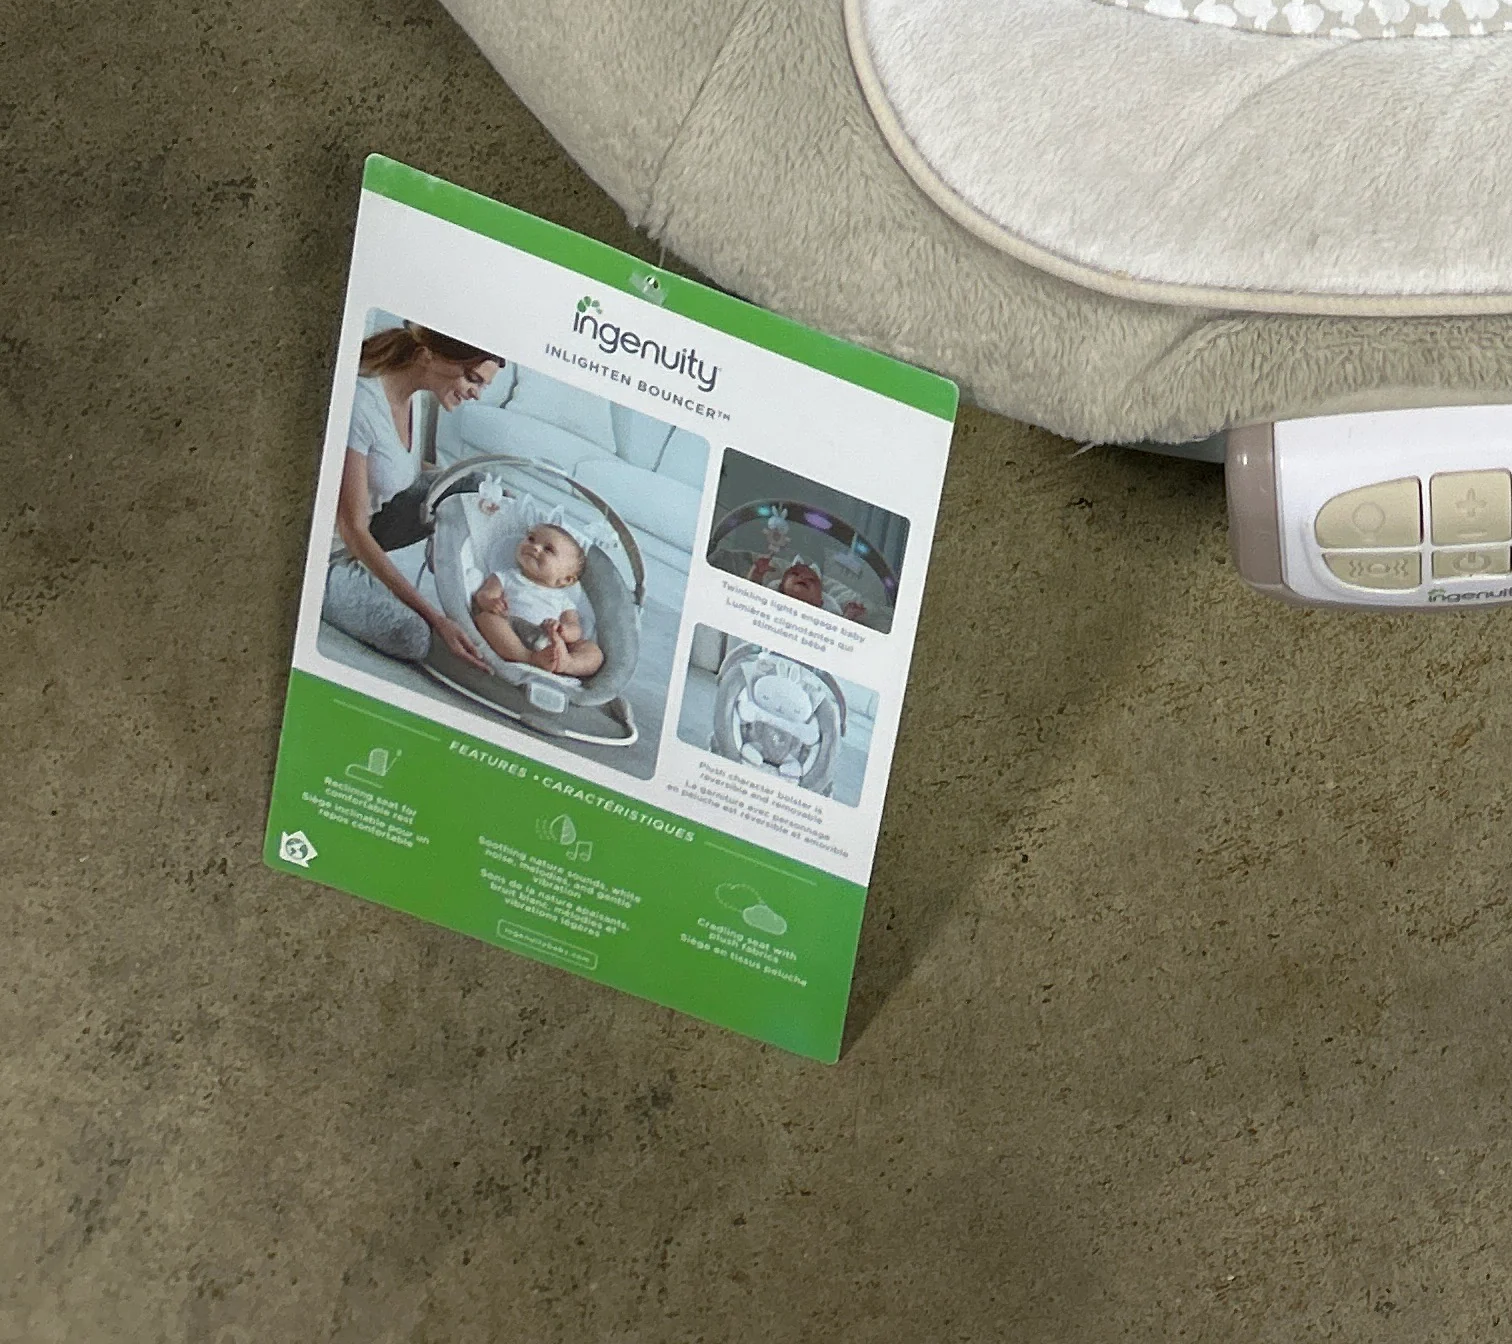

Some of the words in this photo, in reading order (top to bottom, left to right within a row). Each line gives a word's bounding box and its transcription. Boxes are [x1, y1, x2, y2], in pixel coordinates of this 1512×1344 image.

[545, 344, 631, 386] INLIGHTEN
[573, 312, 717, 392] ingenuity
[450, 741, 527, 778] FEATURES
[542, 777, 696, 842] CARACTÉRISTIQUES
